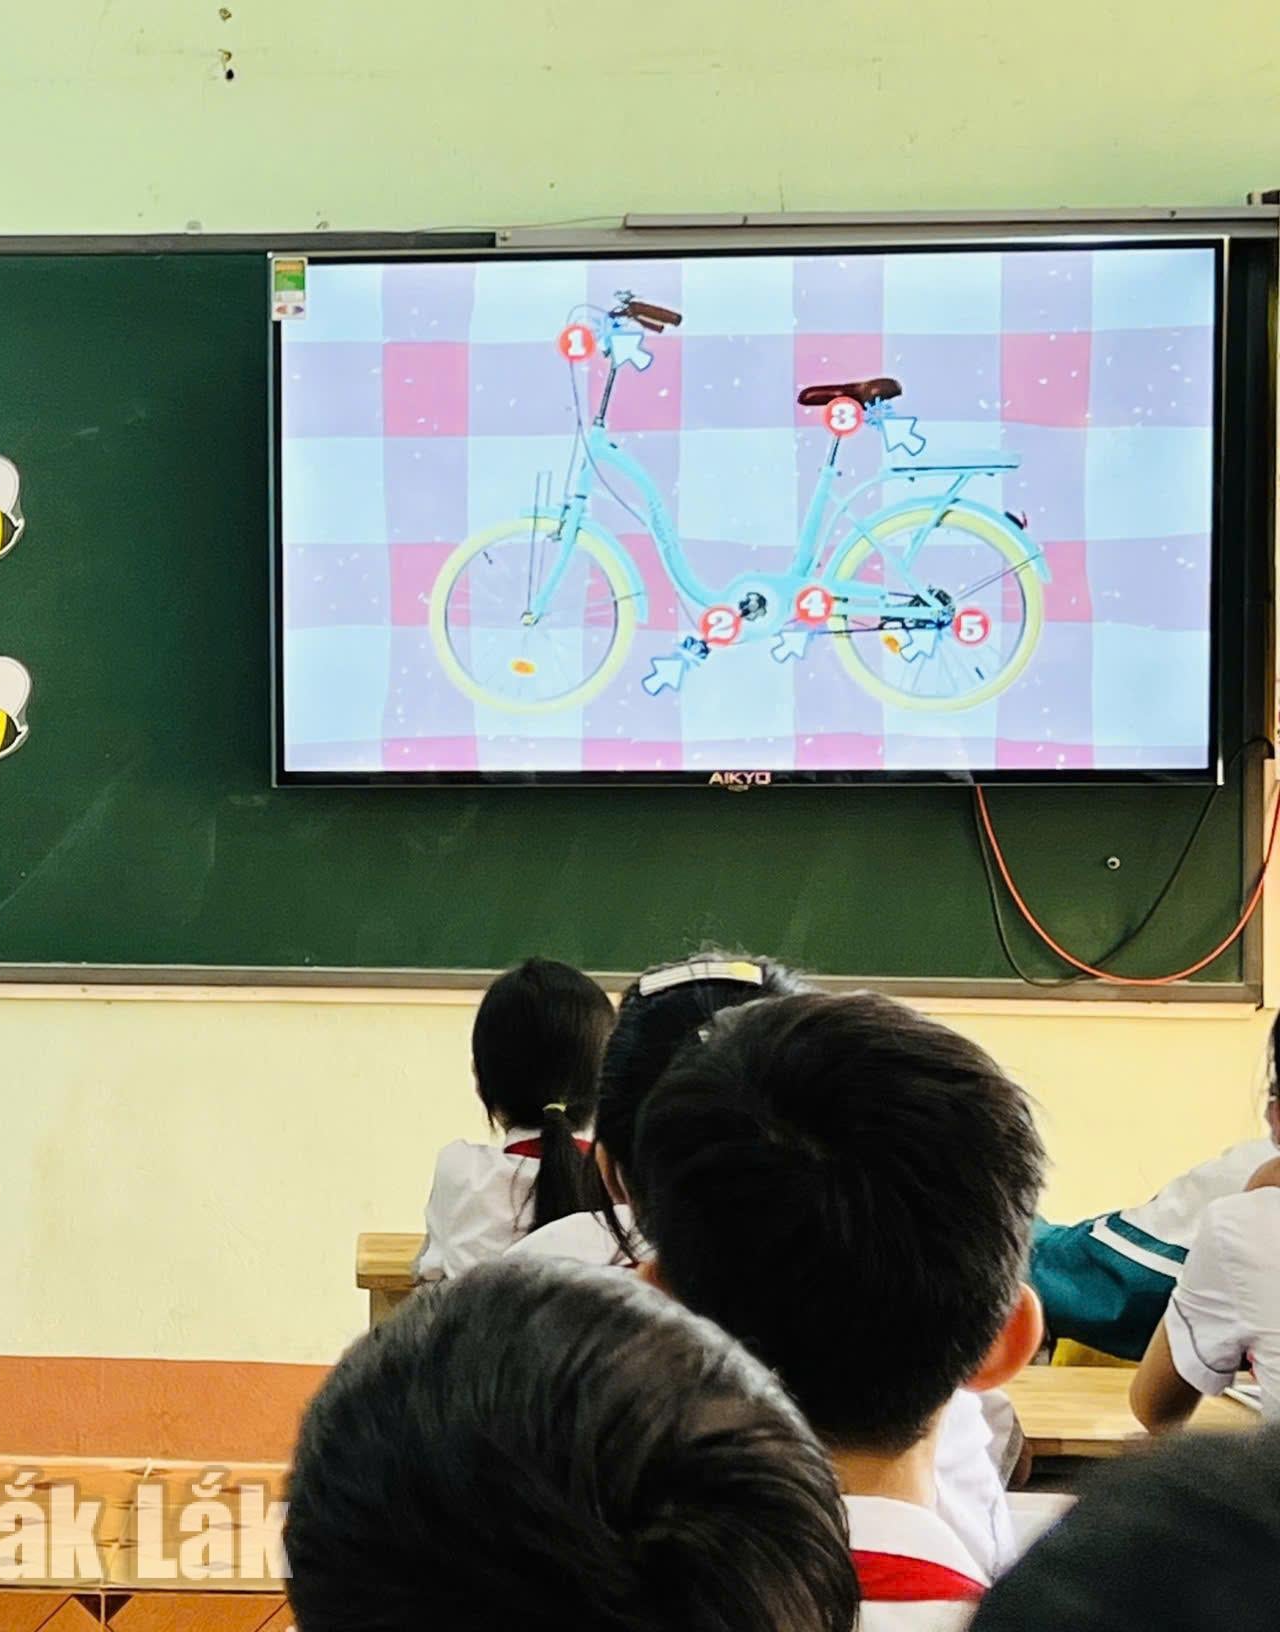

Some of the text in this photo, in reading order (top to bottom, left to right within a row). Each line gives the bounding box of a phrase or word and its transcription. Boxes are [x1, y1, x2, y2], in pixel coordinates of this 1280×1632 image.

[567, 329, 586, 356] 1
[830, 403, 858, 430] 3
[799, 590, 825, 618] 4
[707, 610, 735, 640] 2
[959, 614, 984, 641] 5
[708, 771, 772, 785] AIKYO
